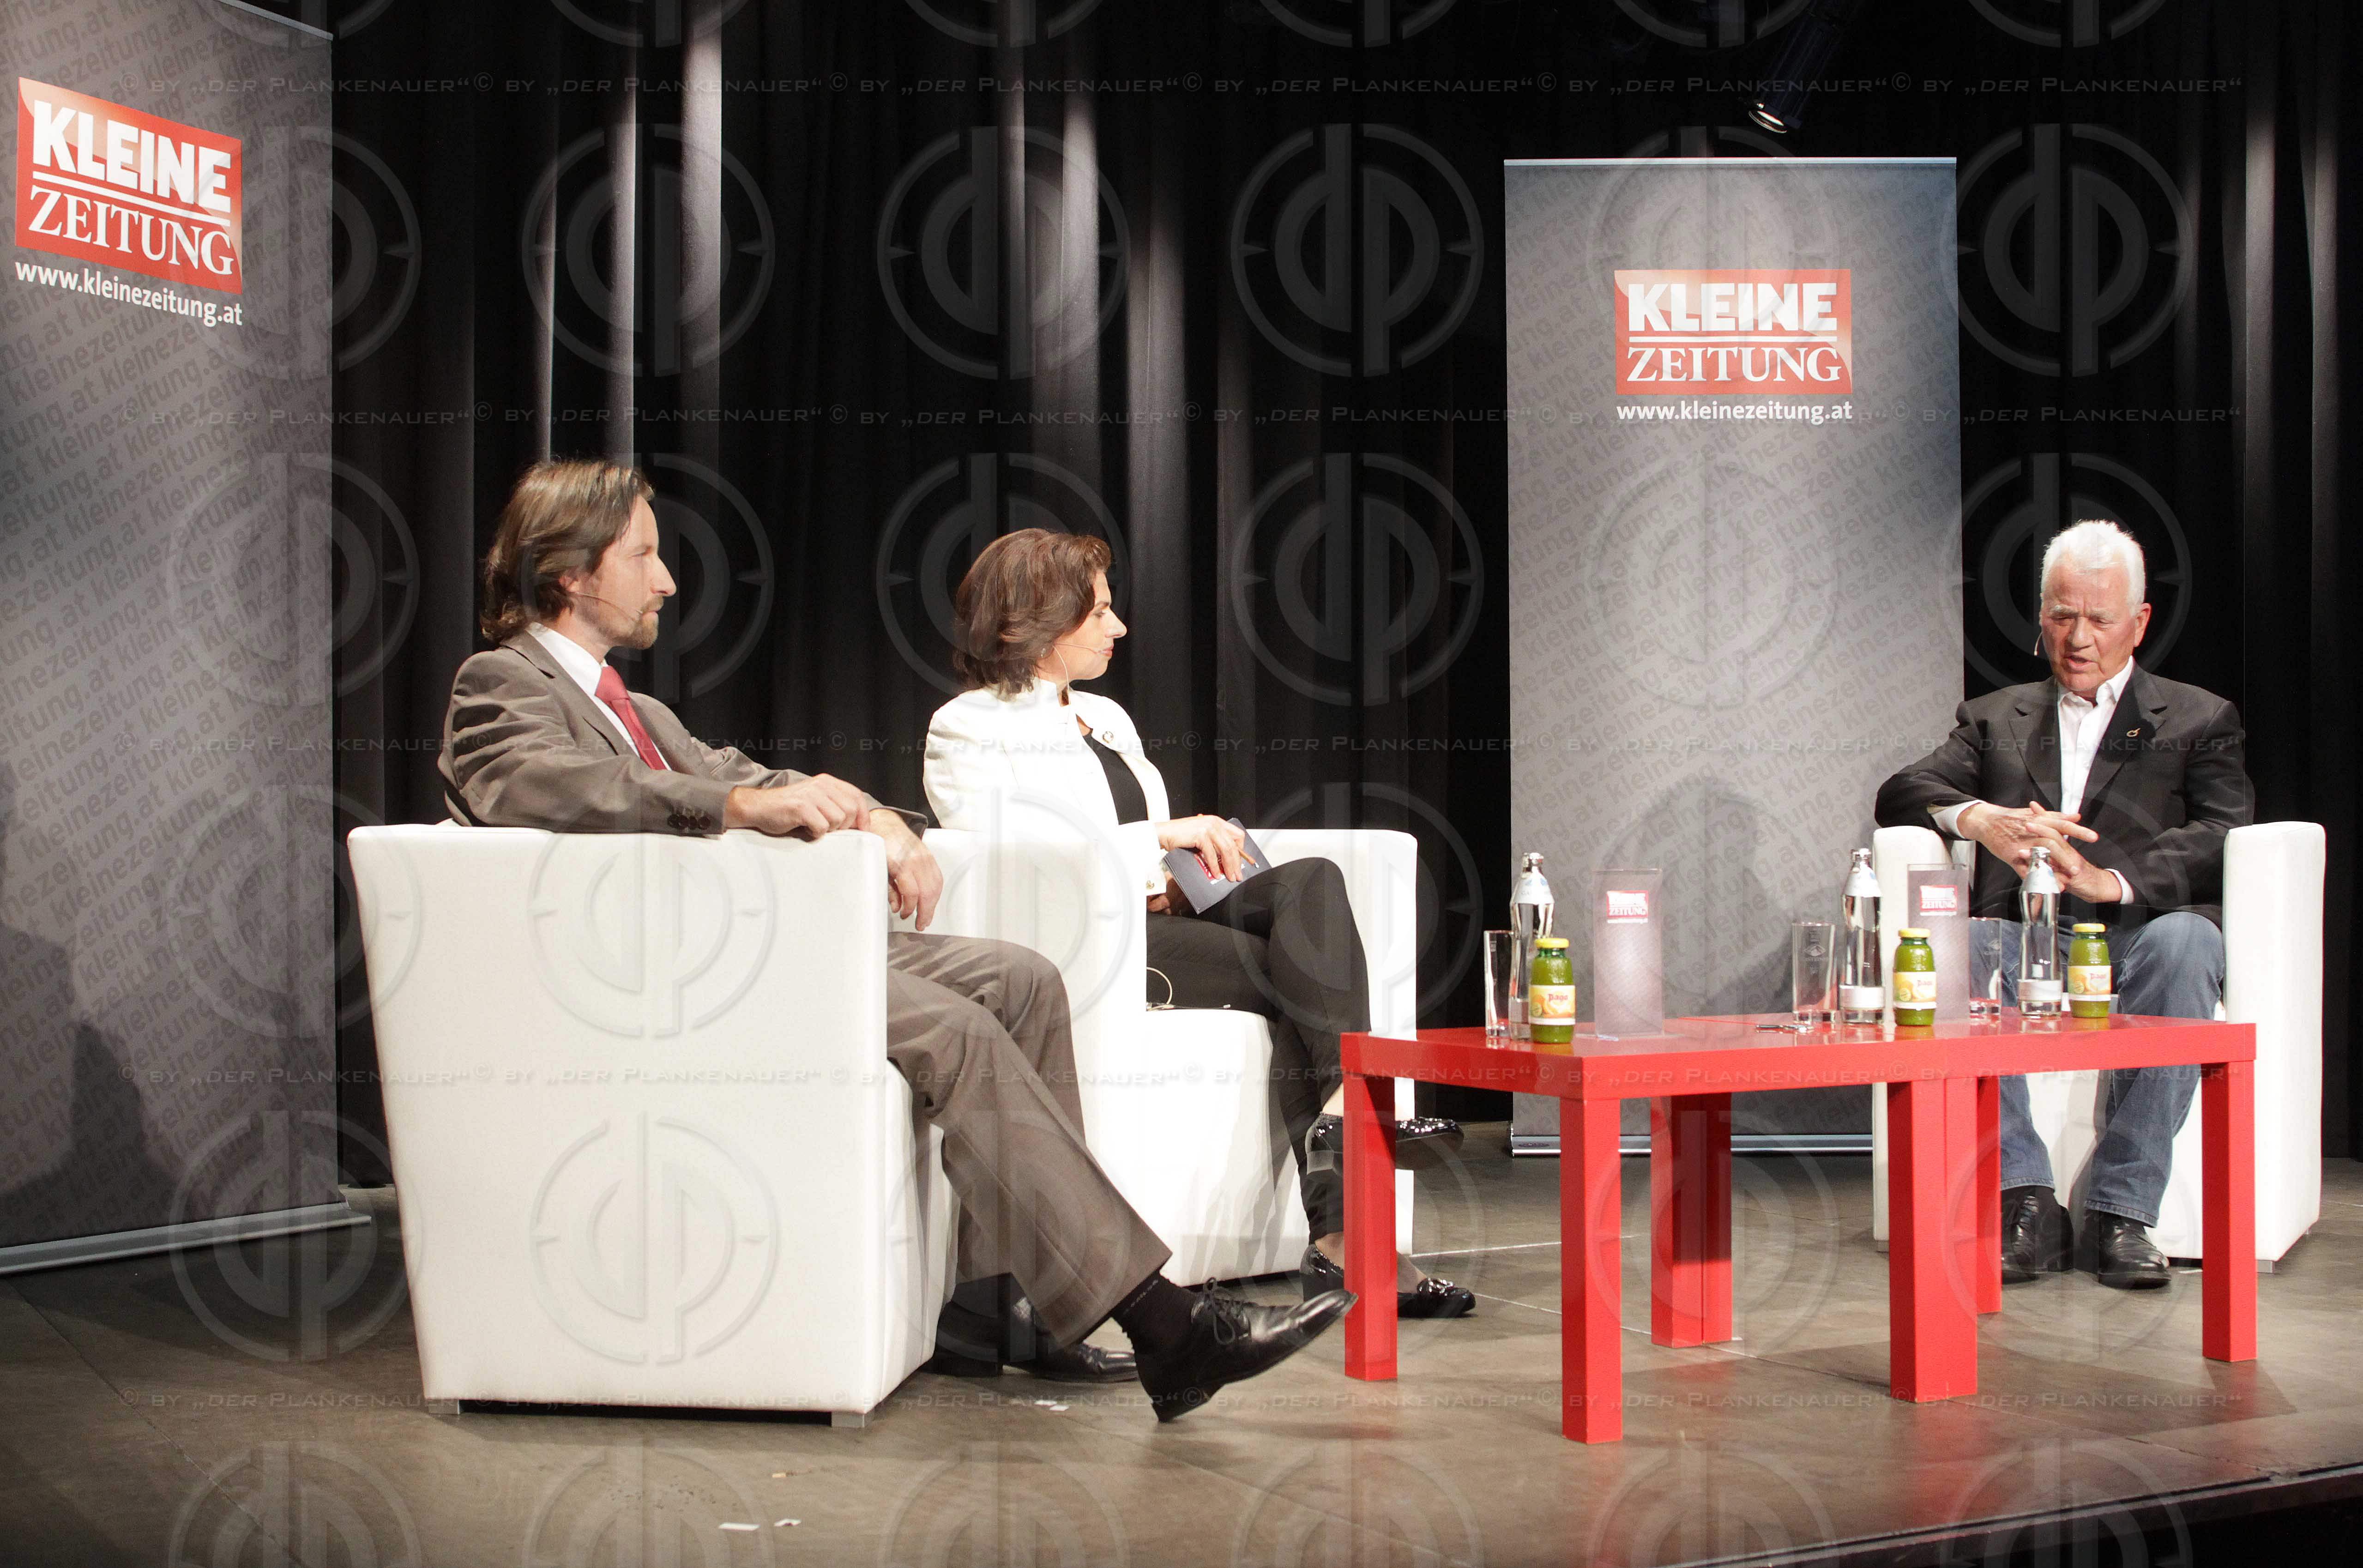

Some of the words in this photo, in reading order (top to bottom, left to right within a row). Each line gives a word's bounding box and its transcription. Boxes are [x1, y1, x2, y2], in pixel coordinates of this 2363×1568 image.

[33, 99, 231, 213] KLEINE
[29, 185, 234, 275] ZEITUNG
[15, 261, 242, 327] www.kleinezeitung.at
[1628, 283, 1837, 332] KLEINE
[1627, 346, 1842, 382] ZEITUNG
[1616, 400, 1853, 425] www.kleinezeitung.at
